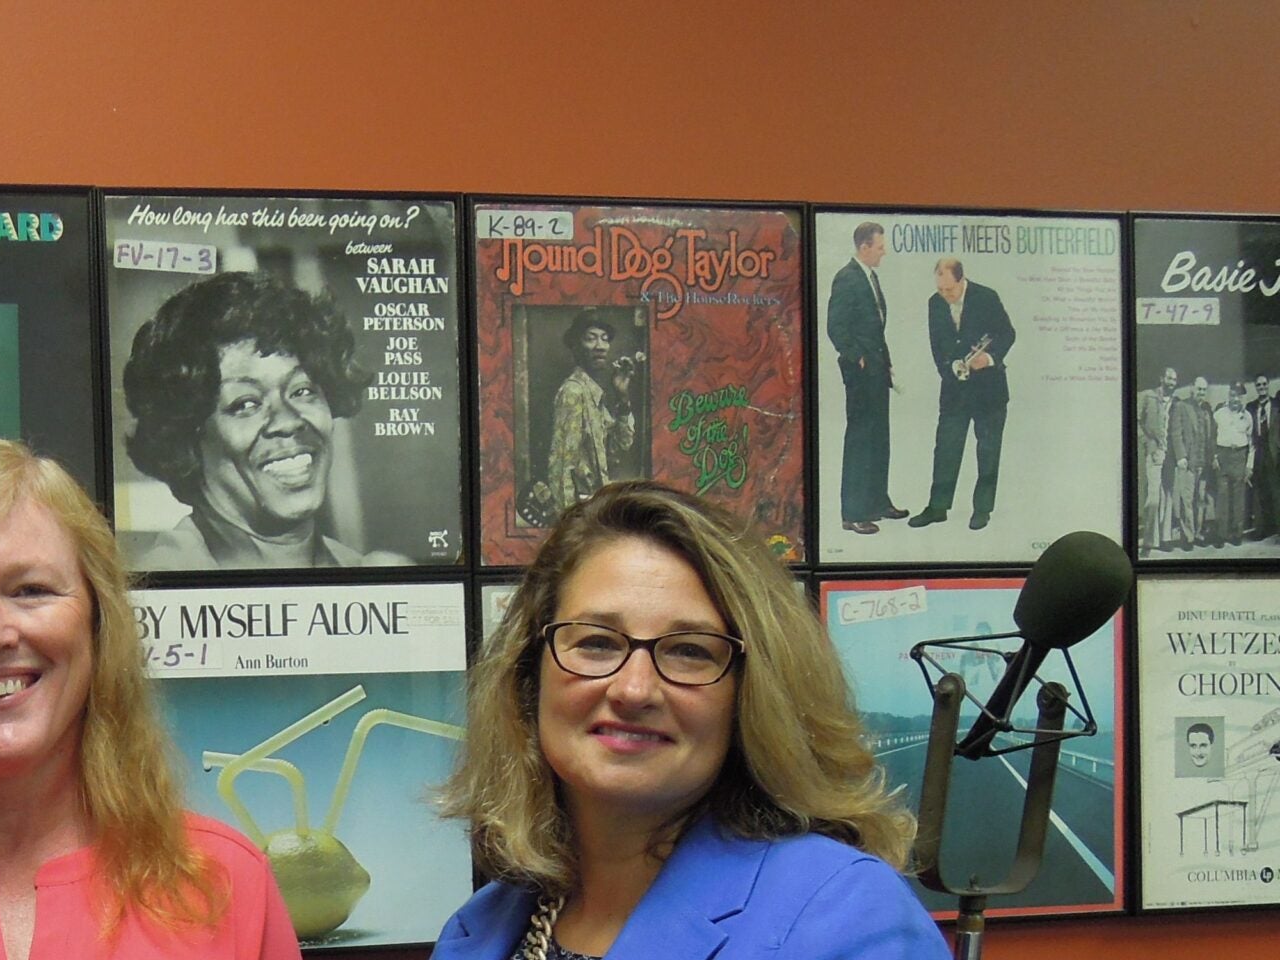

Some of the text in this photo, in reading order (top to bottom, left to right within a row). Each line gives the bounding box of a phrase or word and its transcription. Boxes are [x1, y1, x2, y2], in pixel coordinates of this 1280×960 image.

[128, 203, 420, 235] How long has this been going on?
[489, 215, 565, 237] K-89-2
[892, 223, 1116, 256] CONNIFF MEETS BUTTERFIELD
[345, 240, 393, 255] between
[367, 257, 436, 275] SARAH
[609, 226, 685, 319] Dog
[676, 228, 776, 293] Taylor
[1161, 250, 1257, 293] Basie
[355, 276, 449, 294] VAUGHAN
[374, 302, 431, 317] OSCAR
[363, 316, 446, 331] PETERSON
[386, 336, 419, 351] JOE
[384, 351, 423, 366] PASS
[378, 371, 431, 386] LOUIE
[367, 386, 443, 400] BELLSON
[389, 407, 420, 422] RAY
[374, 422, 435, 436] BROWN
[179, 603, 299, 640] MYSELF
[307, 601, 410, 636] ALONE
[1178, 610, 1207, 621] DINU
[1211, 610, 1257, 621] LIPATTI
[235, 654, 309, 671] Ann Burton
[1187, 869, 1258, 883] COLUMBIA
